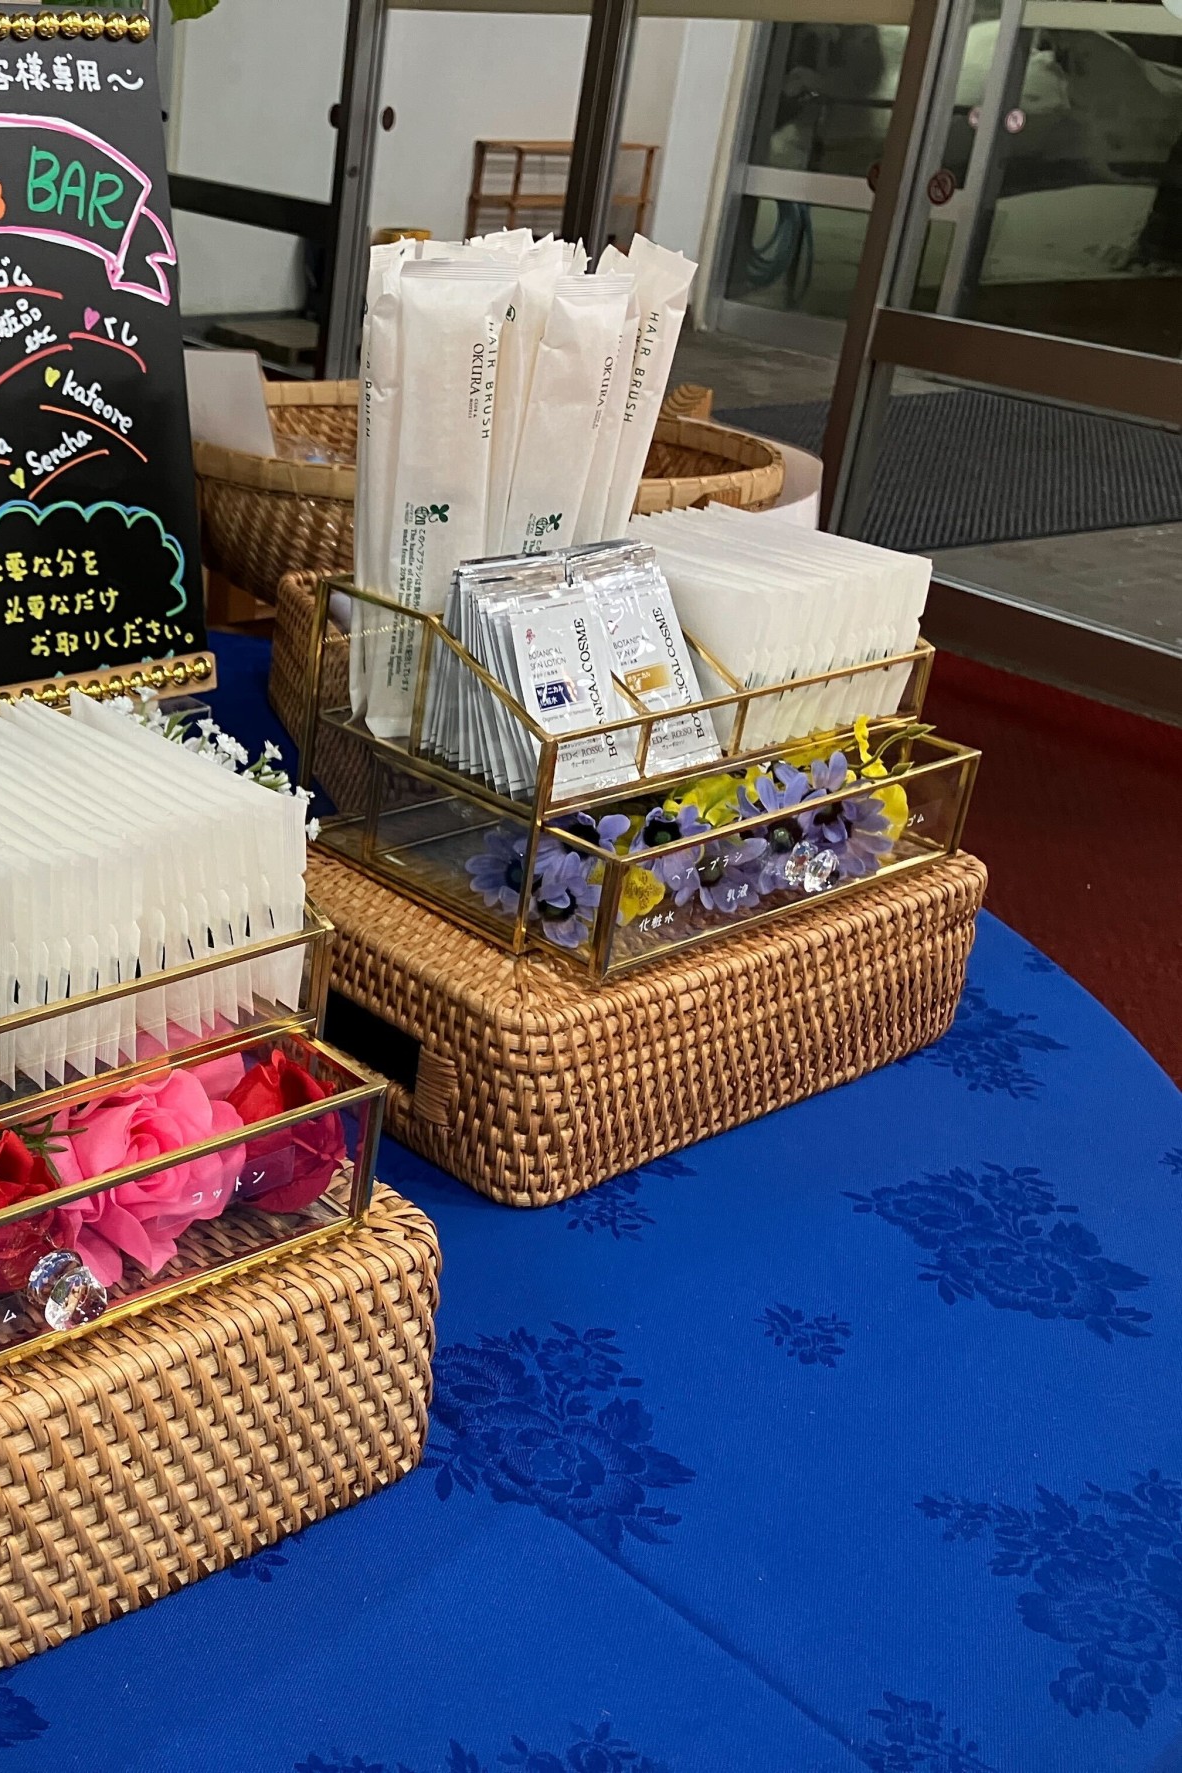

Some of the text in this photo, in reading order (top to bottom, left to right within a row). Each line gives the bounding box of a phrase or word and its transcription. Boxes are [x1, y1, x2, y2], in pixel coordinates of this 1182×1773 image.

[27, 145, 125, 229] BAR
[25, 325, 58, 354] etc
[640, 311, 660, 357] HAIR
[470, 343, 485, 396] OKURA
[597, 356, 614, 407] OKURA
[481, 381, 494, 439] BRUSH
[623, 367, 646, 423] BRUSH
[26, 430, 93, 475] Sencha
[672, 851, 743, 881] ヘアーブラシ
[638, 910, 675, 933] 化粧水
[191, 1171, 266, 1206] コットン
